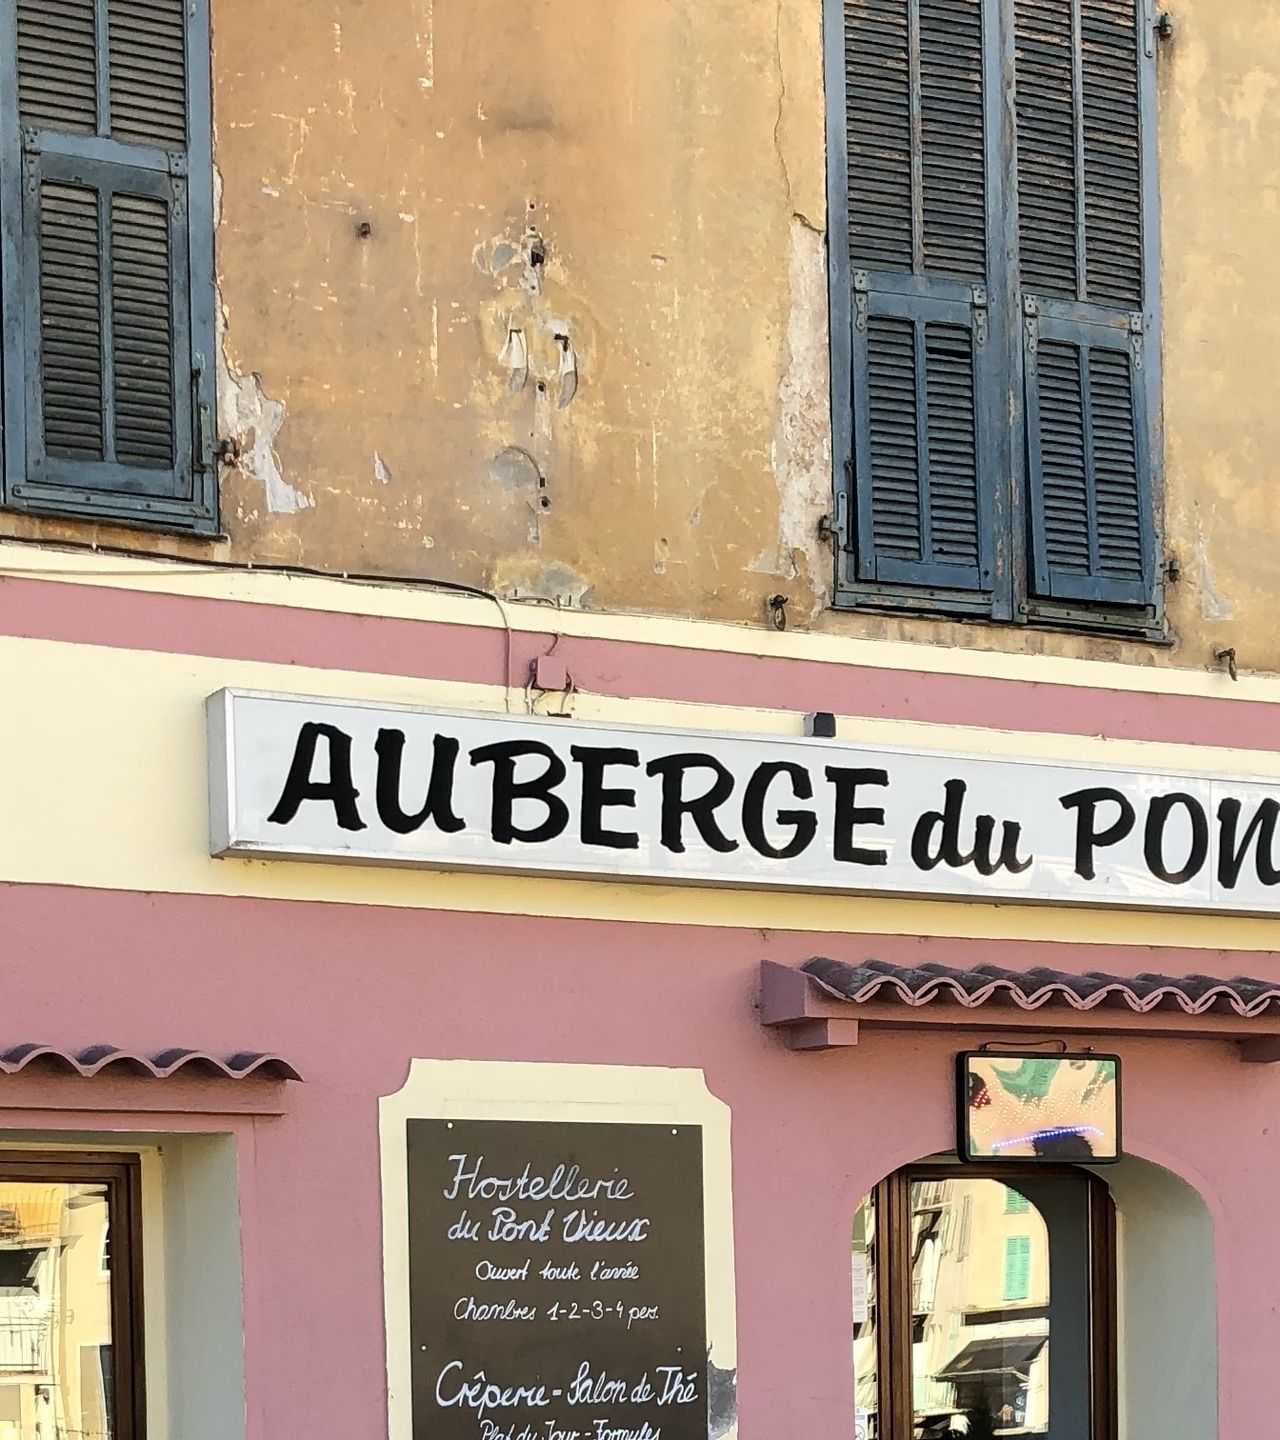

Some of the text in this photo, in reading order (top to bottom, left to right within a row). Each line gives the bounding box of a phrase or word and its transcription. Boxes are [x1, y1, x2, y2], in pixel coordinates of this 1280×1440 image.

[267, 721, 889, 866] AUBERGE
[911, 778, 1032, 876] du
[443, 1153, 635, 1201] Hostellerie
[447, 1206, 651, 1243] du Pont Vieux
[475, 1258, 531, 1281] Ouvert
[538, 1260, 582, 1281] toute
[453, 1296, 537, 1321] Chambres
[435, 1360, 550, 1420] Crêperie
[566, 1360, 628, 1406] Salon
[630, 1371, 656, 1405] de
[655, 1365, 699, 1407] Thé
